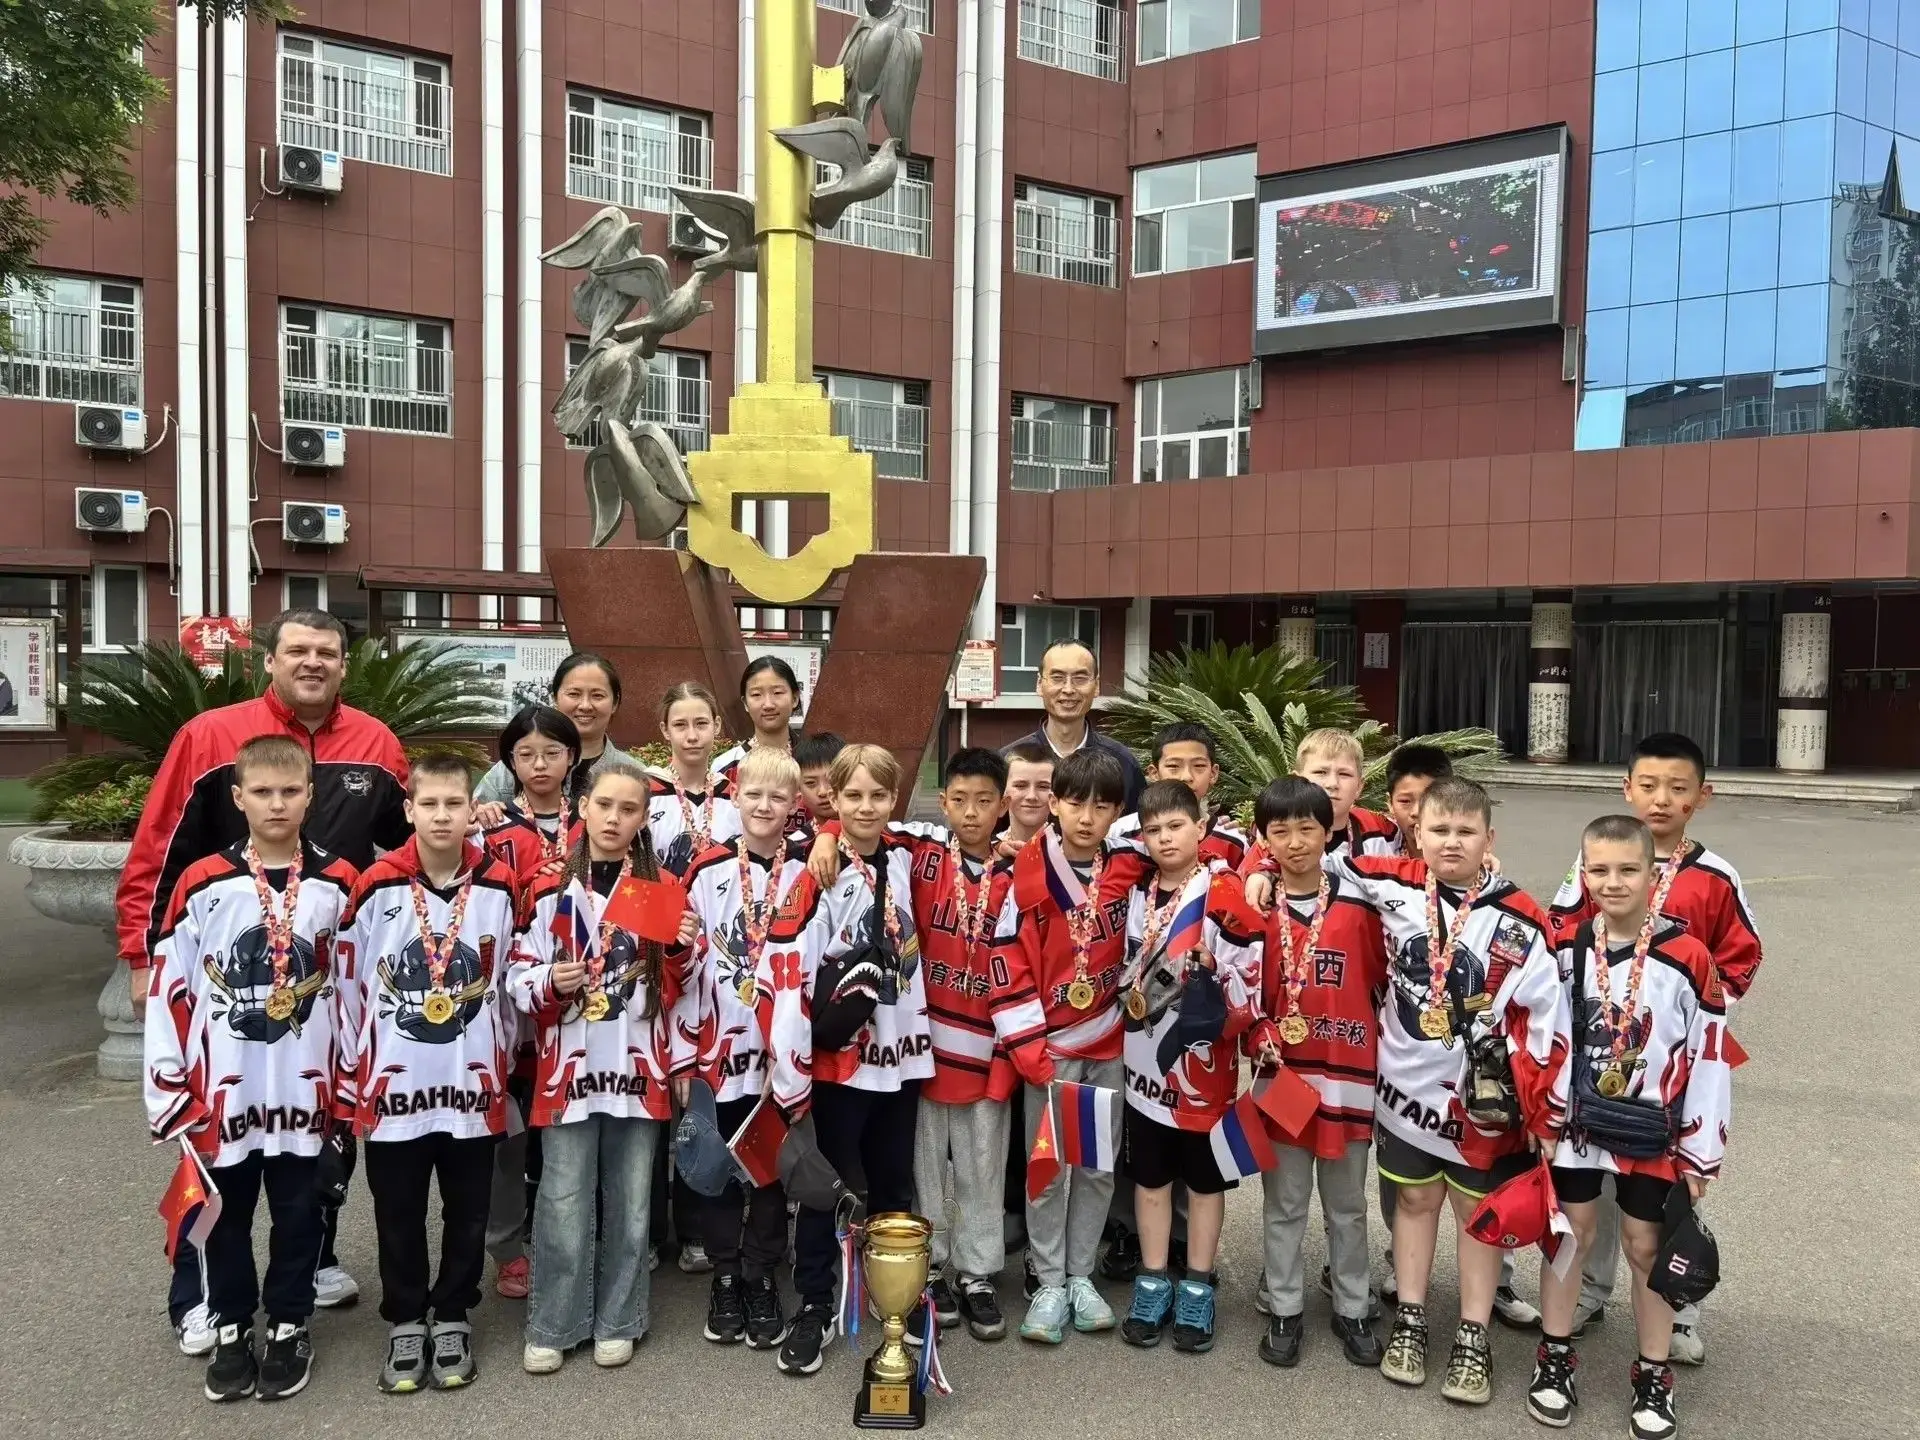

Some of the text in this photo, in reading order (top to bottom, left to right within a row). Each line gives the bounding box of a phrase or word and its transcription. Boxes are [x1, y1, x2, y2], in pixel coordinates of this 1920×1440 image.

[769, 950, 801, 992] 88
[921, 957, 993, 998] 育杰学
